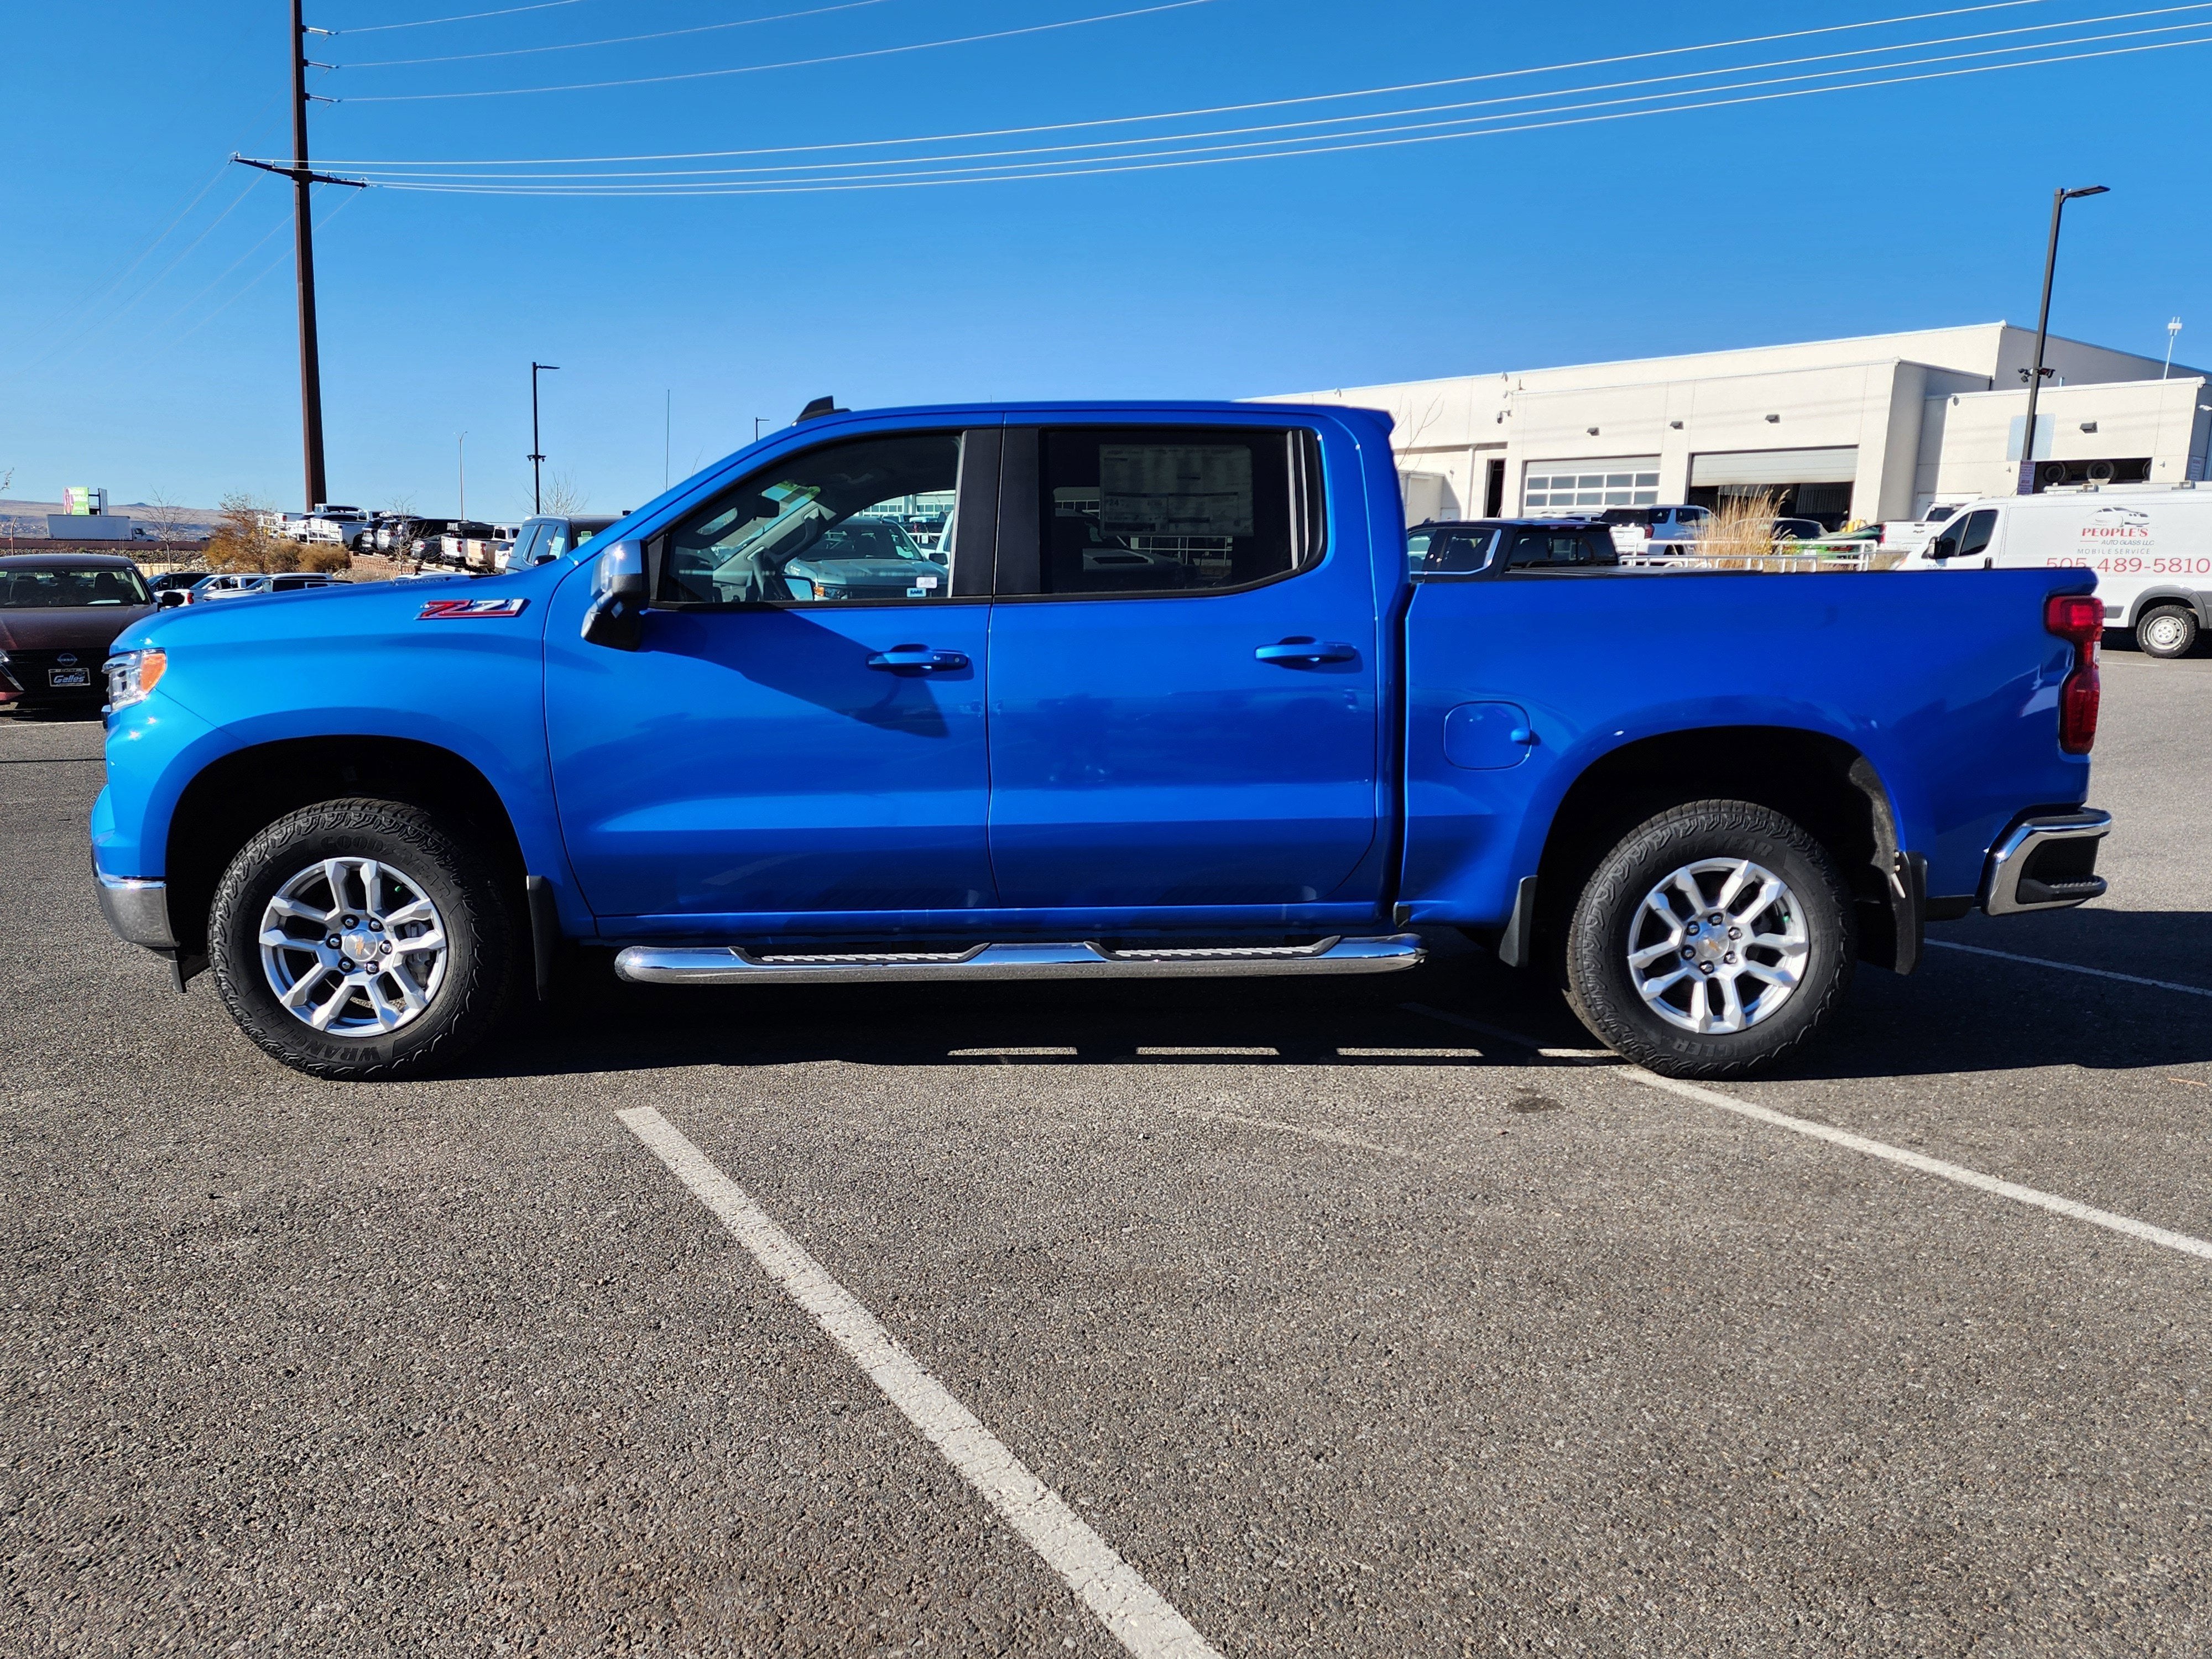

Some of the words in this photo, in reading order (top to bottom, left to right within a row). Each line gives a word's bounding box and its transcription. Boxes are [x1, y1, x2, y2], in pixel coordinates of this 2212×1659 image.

[2081, 528, 2149, 537] PEOPLE'S
[2046, 557, 2210, 573] 505-489-5810
[414, 598, 530, 620] Z71
[54, 675, 85, 684] Galles
[320, 834, 451, 900] GOODYEAR
[256, 1000, 382, 1062] WRANGLER
